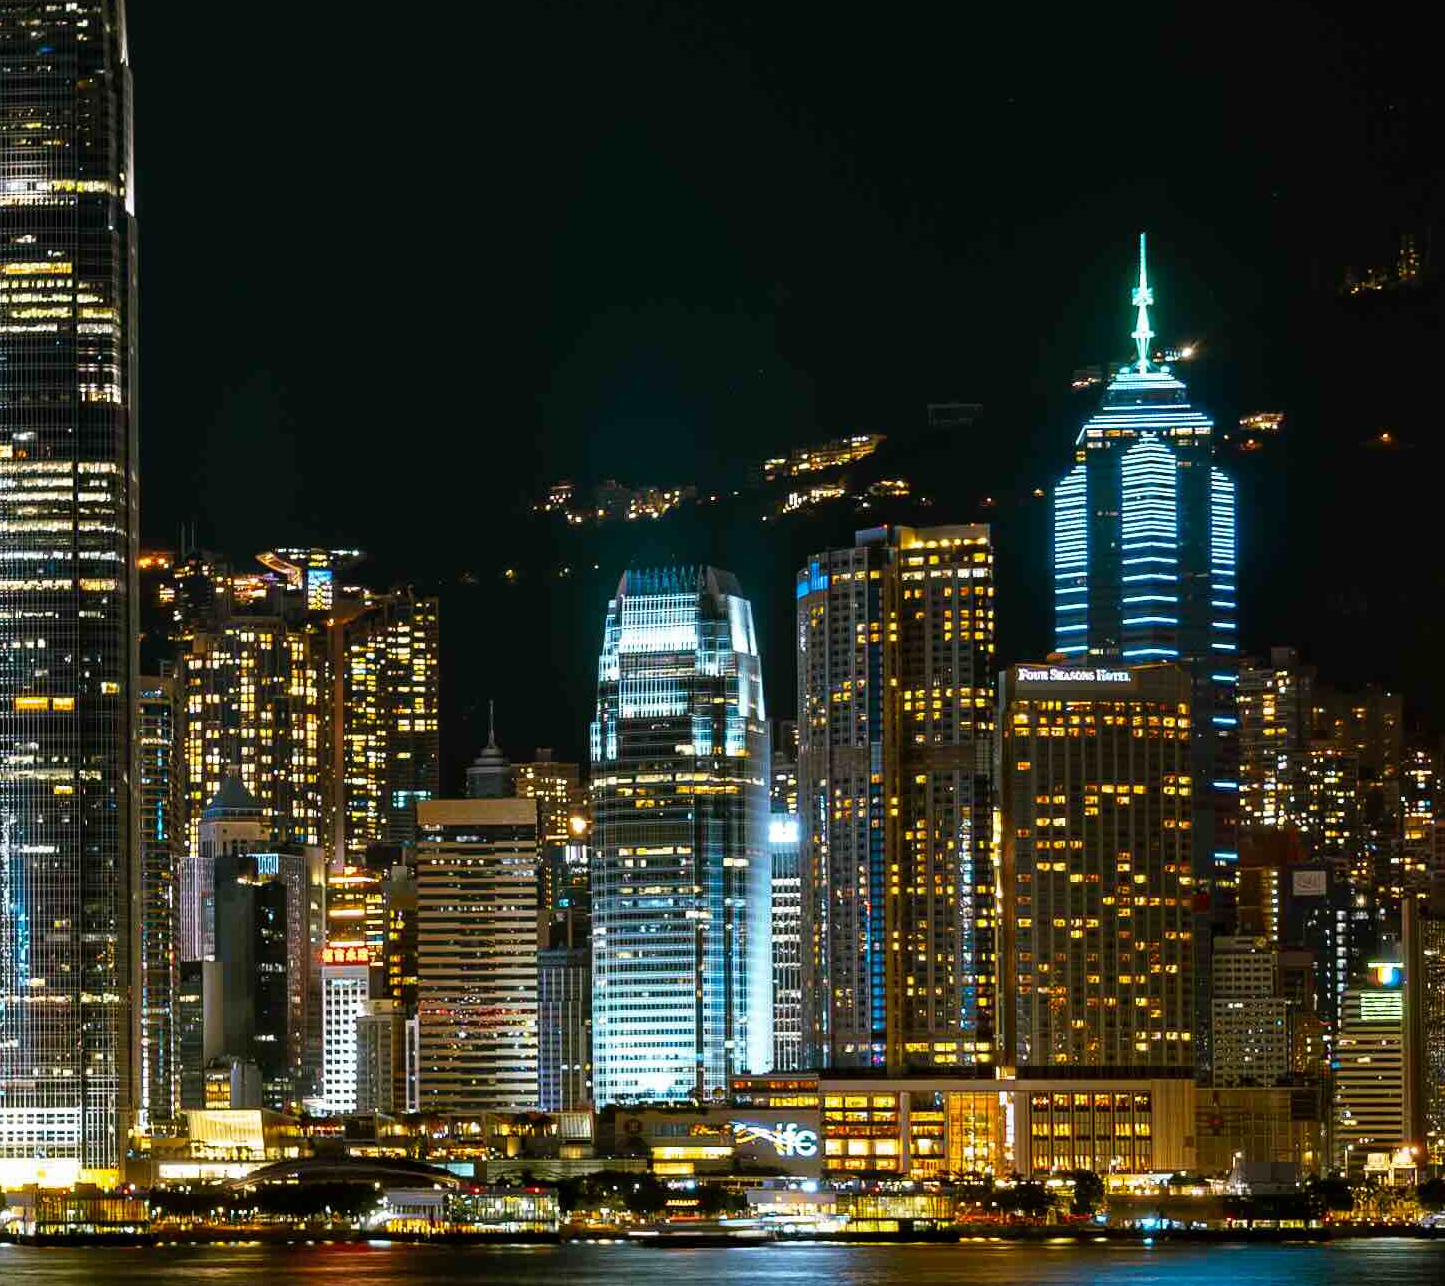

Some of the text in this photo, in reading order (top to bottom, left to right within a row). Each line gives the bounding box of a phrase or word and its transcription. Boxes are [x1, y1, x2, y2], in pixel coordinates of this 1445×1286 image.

[1018, 668, 1131, 682] FOUR SEASONS HOTEL
